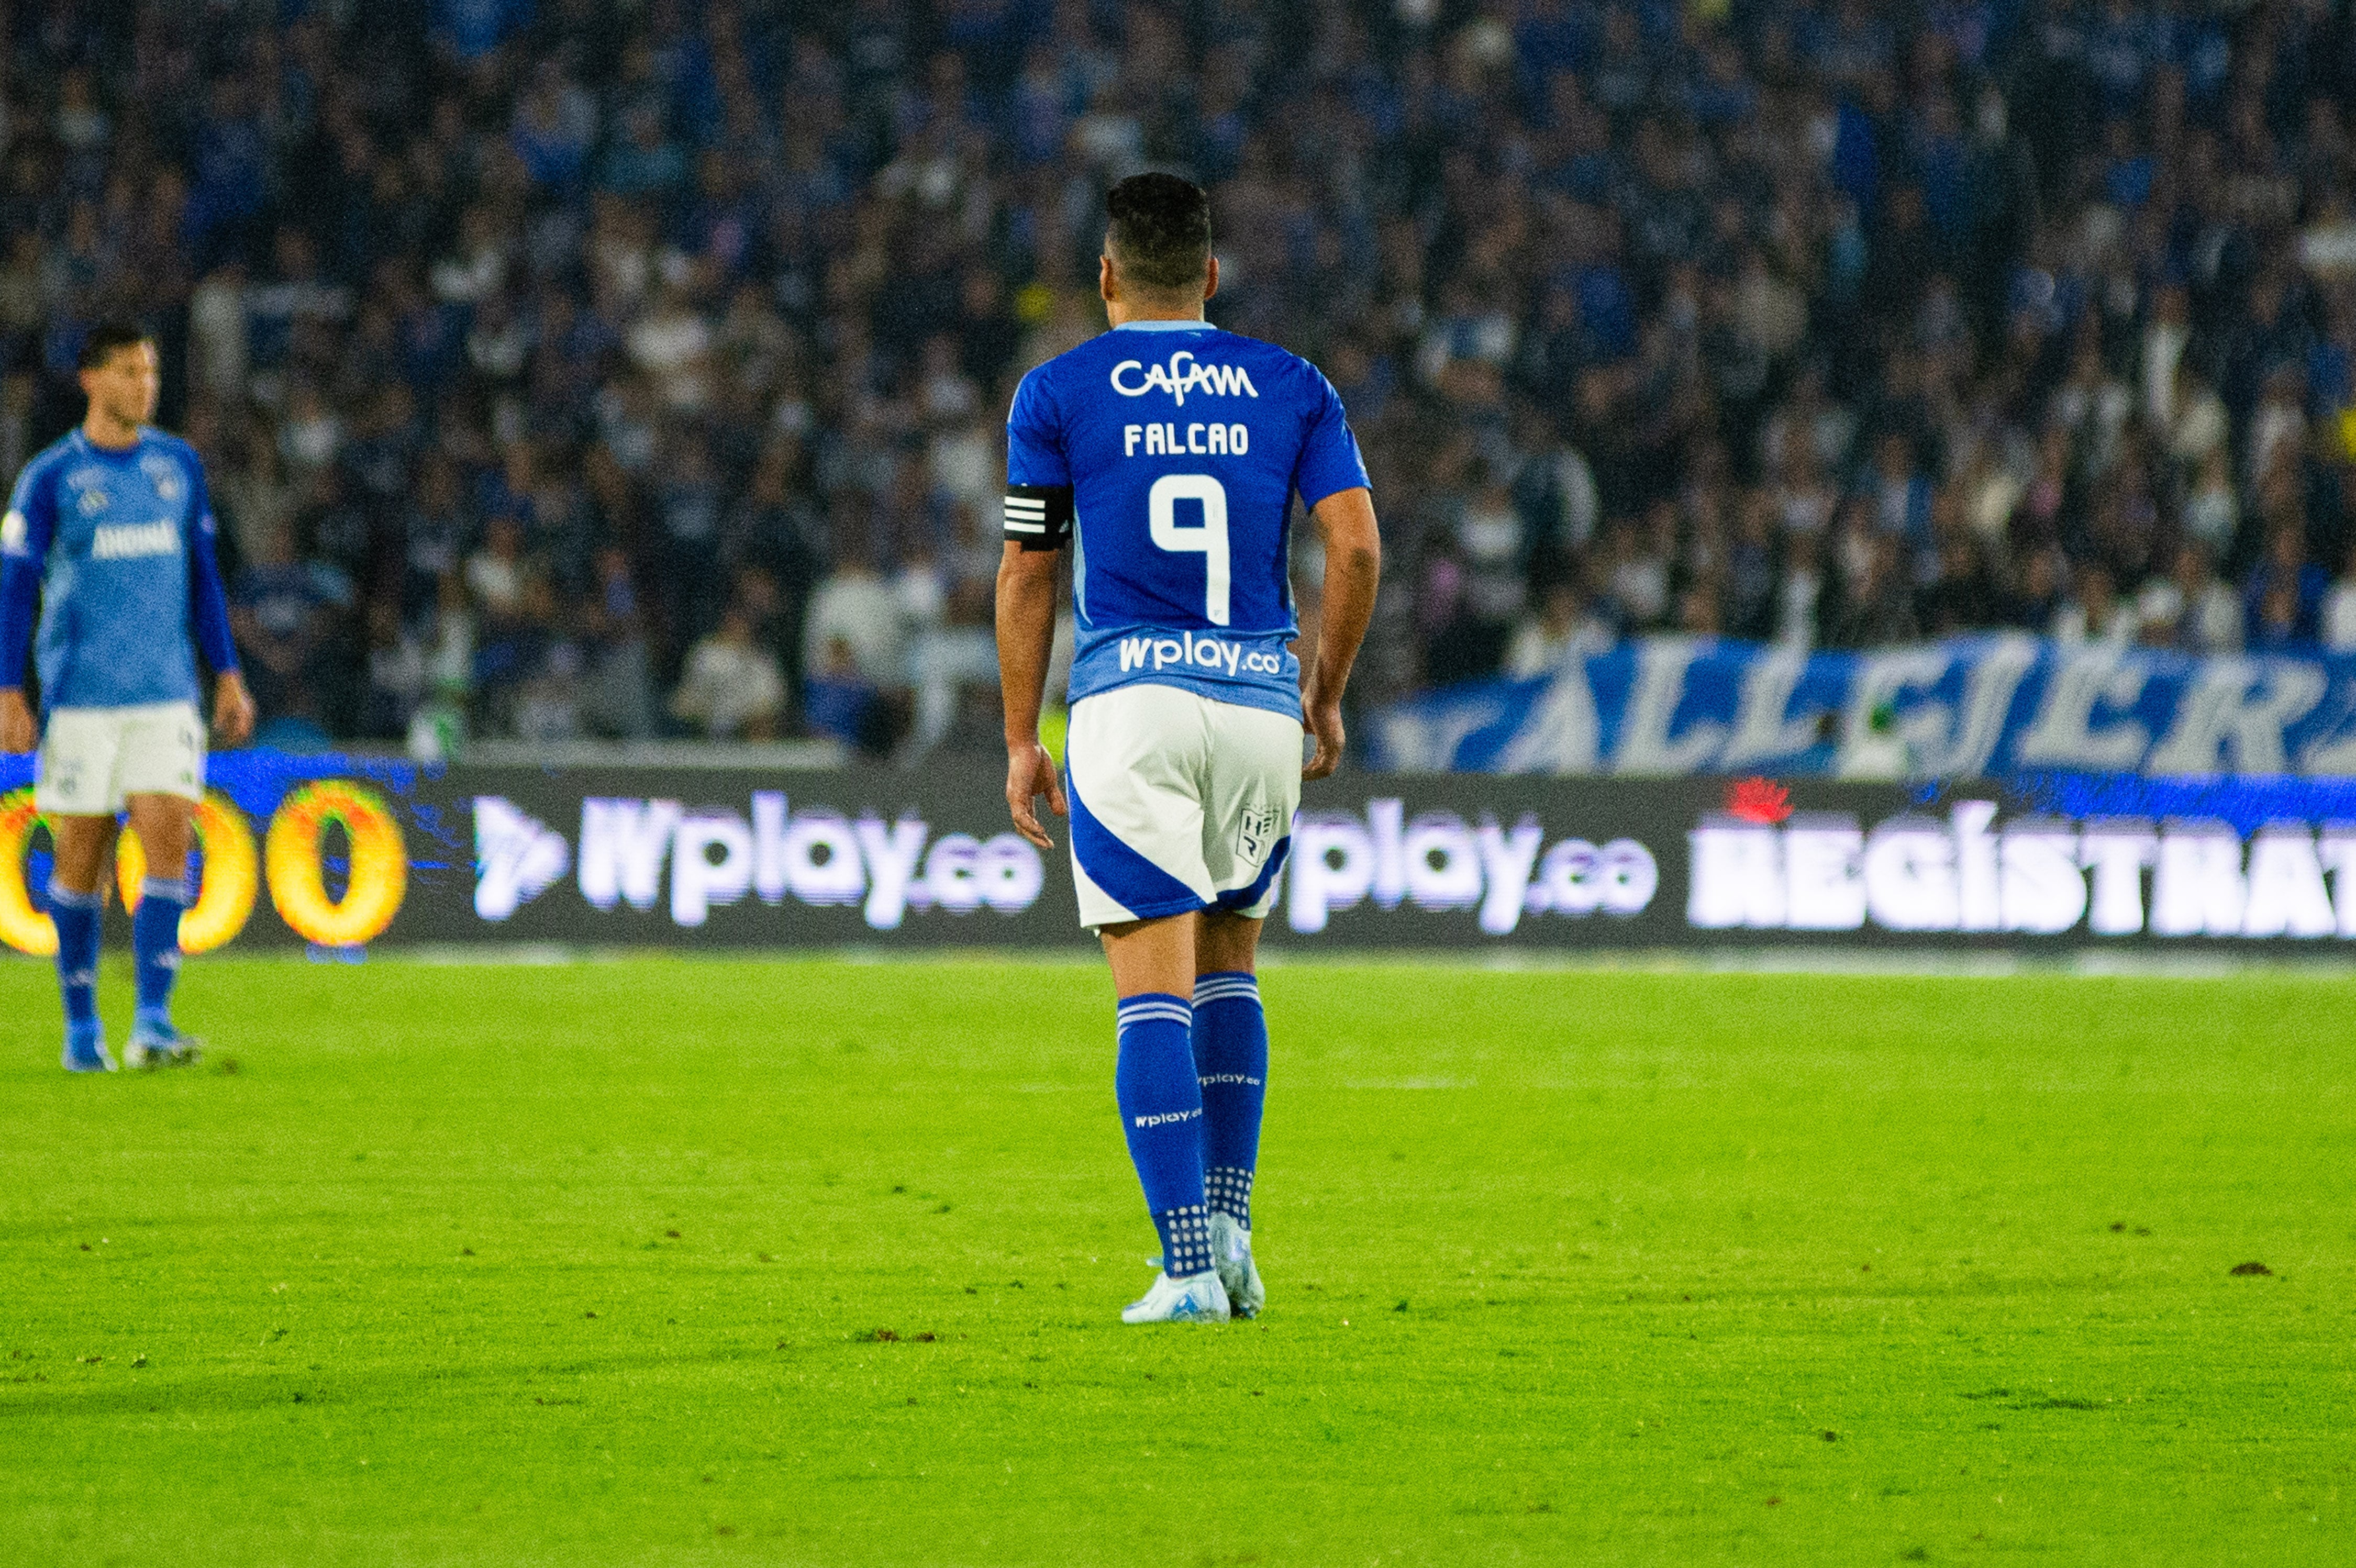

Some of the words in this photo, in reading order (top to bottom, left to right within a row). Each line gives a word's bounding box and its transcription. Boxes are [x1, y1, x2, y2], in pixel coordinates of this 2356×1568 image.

[1124, 423, 1248, 456] FALCAO
[1149, 474, 1230, 626] 9
[1119, 631, 1280, 676] Wplay.co
[578, 789, 1043, 929] Wplay.co
[1269, 797, 1659, 935] play.co
